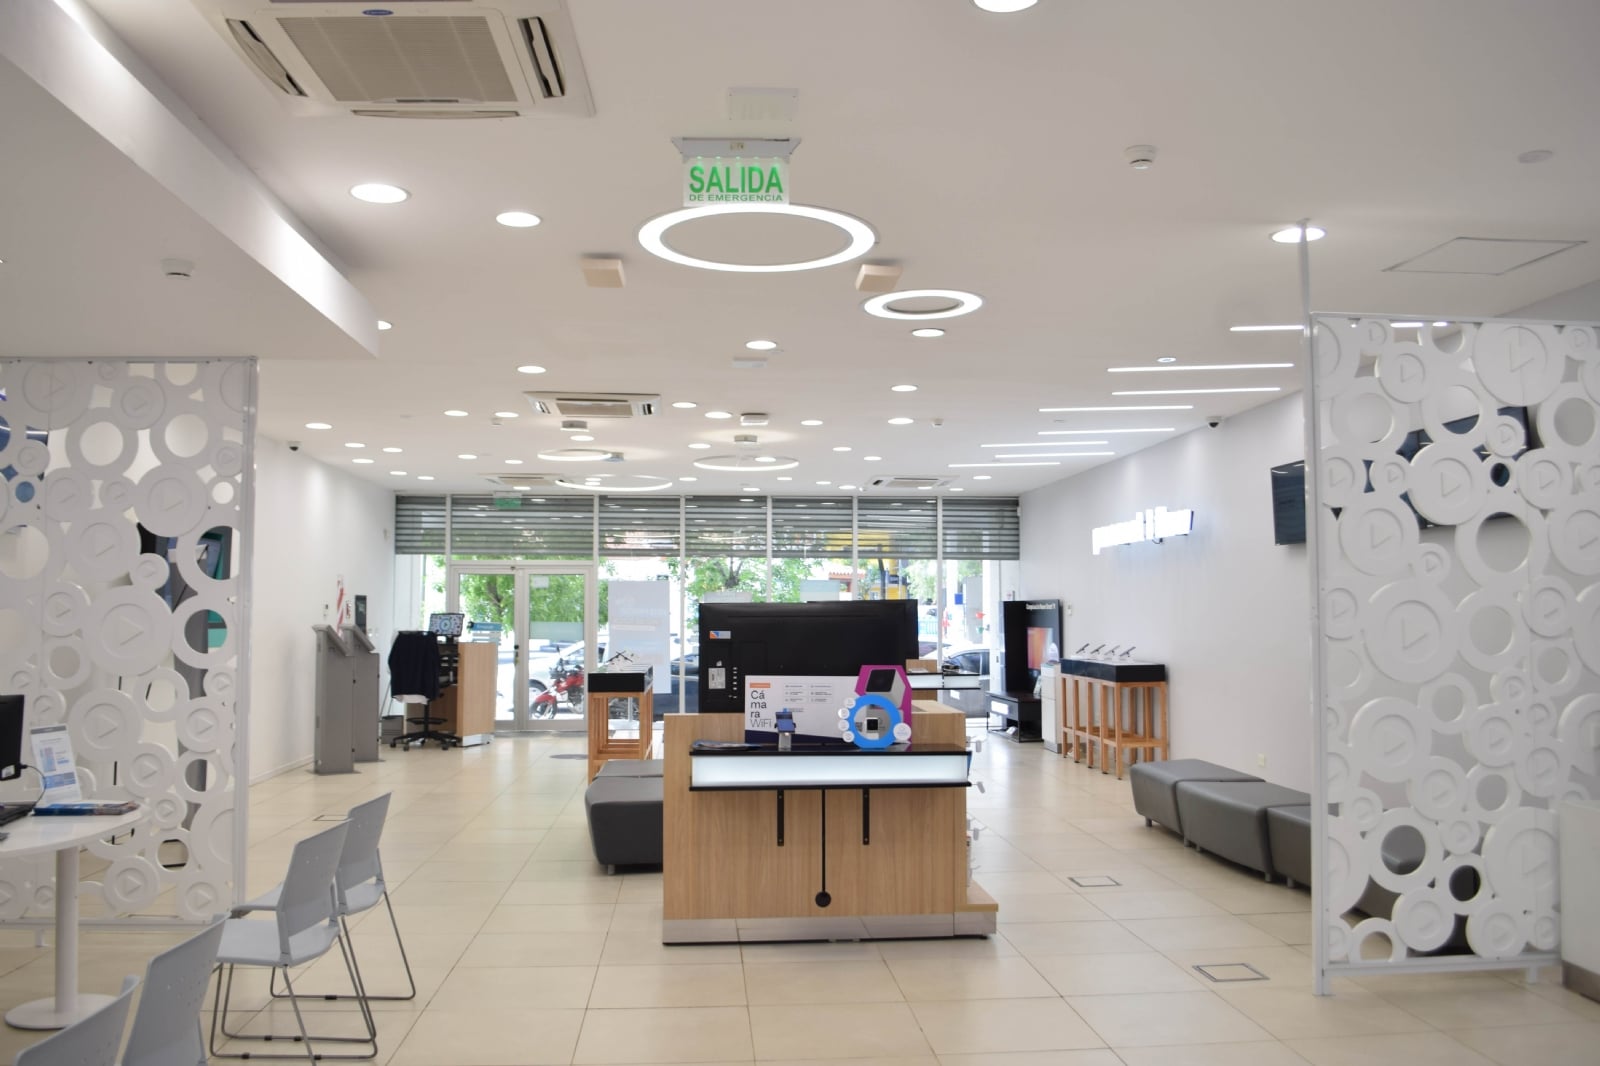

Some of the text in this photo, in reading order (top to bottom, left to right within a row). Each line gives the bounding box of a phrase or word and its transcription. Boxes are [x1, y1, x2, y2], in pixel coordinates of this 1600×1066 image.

[689, 166, 783, 193] SALIDA
[689, 194, 783, 202] DE EMERGENCIA
[750, 689, 765, 700] Cá
[750, 701, 767, 709] ma
